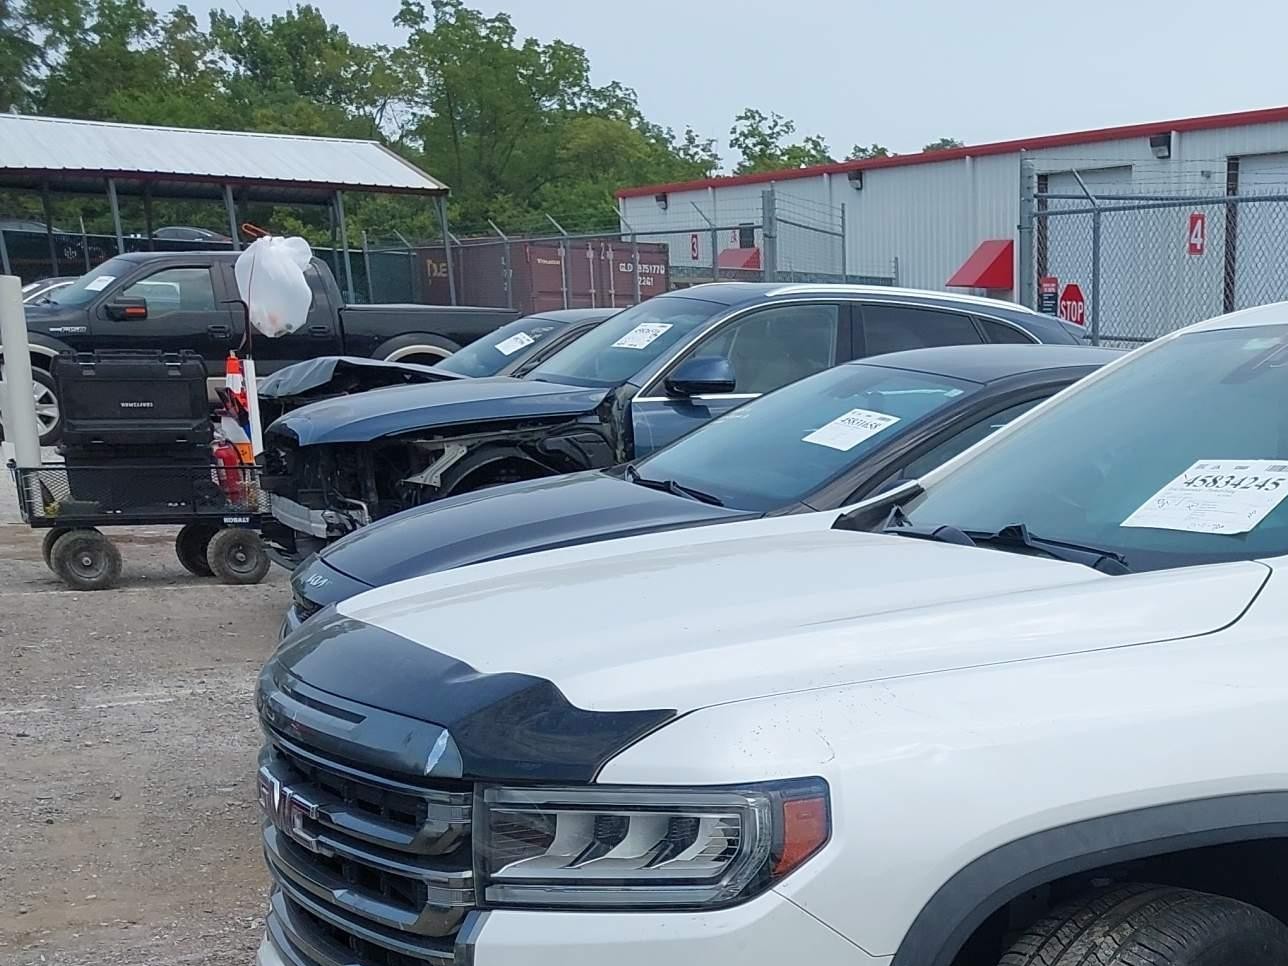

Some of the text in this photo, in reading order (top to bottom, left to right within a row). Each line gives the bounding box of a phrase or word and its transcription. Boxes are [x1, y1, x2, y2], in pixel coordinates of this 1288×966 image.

[1190, 219, 1203, 250] 4
[691, 237, 698, 257] 3
[1060, 300, 1084, 322] STOP
[1183, 474, 1287, 493] 45834245
